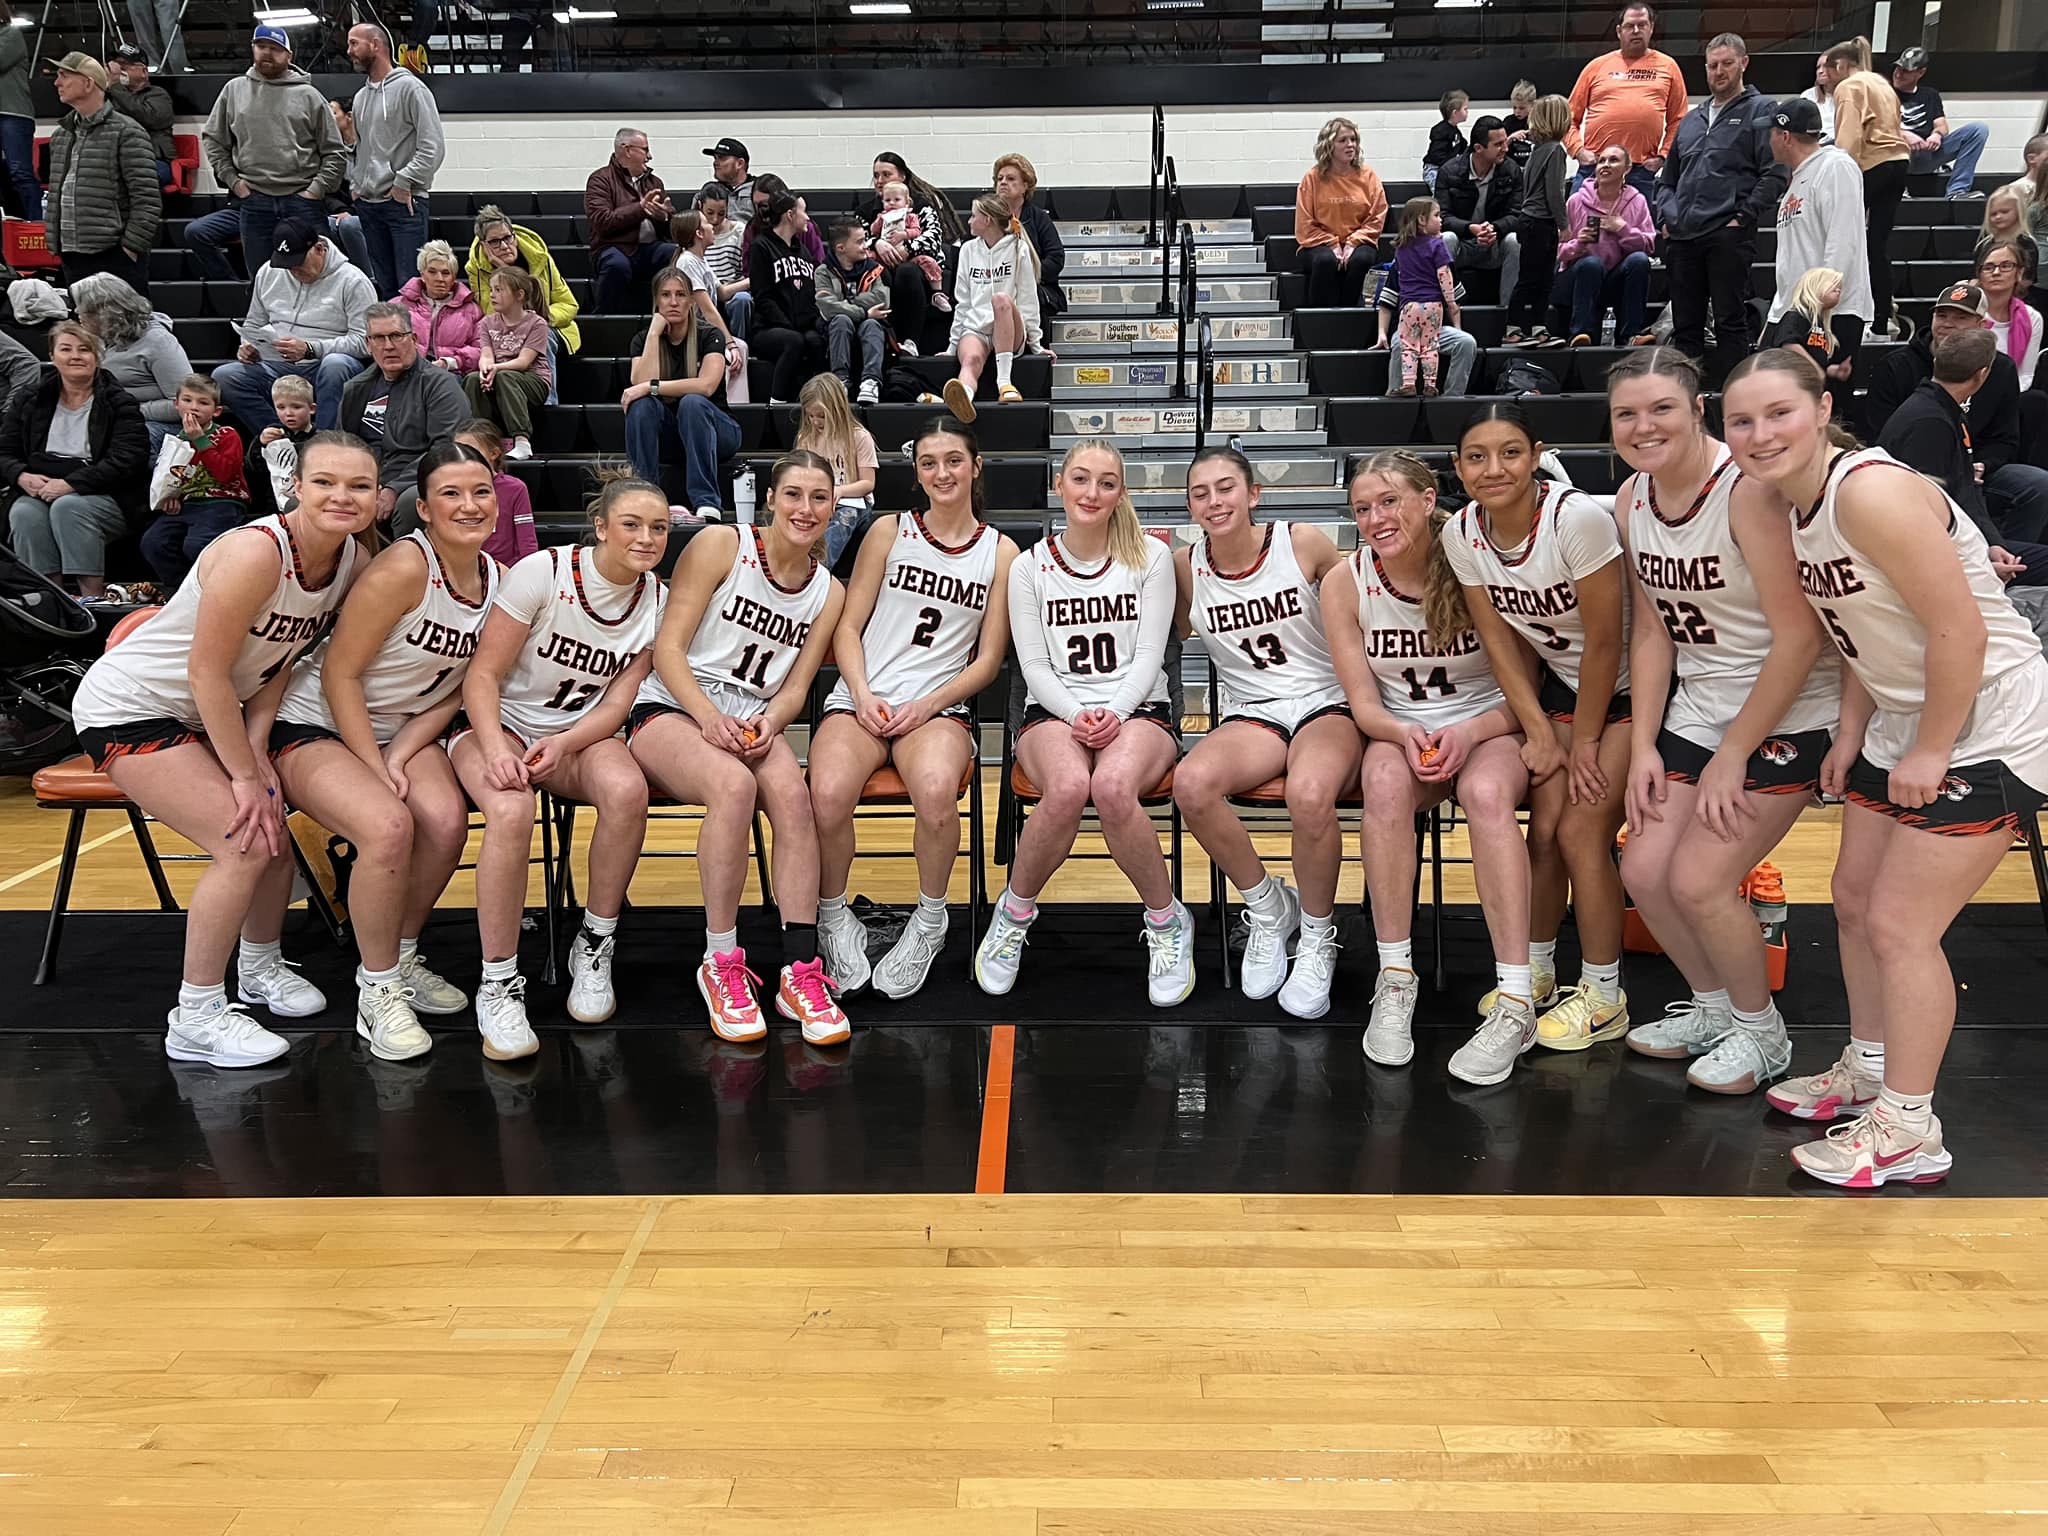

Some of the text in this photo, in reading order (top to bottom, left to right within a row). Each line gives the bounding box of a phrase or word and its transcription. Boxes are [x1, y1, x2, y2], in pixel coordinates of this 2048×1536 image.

[18, 236, 48, 250] SPART
[1108, 323, 1138, 332] Southern
[889, 564, 987, 610] JEROME
[1636, 551, 1726, 591] EROME
[1046, 593, 1138, 627] JEROME
[1207, 587, 1303, 634] JEROME
[1488, 580, 1578, 617] EROME
[721, 595, 811, 649] JEROME
[911, 606, 943, 648] 2
[1655, 598, 1718, 644] 22
[1820, 607, 1859, 659] 5
[731, 642, 776, 689] 11
[1067, 632, 1118, 675] 20
[1238, 632, 1289, 670] 13
[543, 678, 601, 712] 12
[1400, 666, 1458, 701] 14
